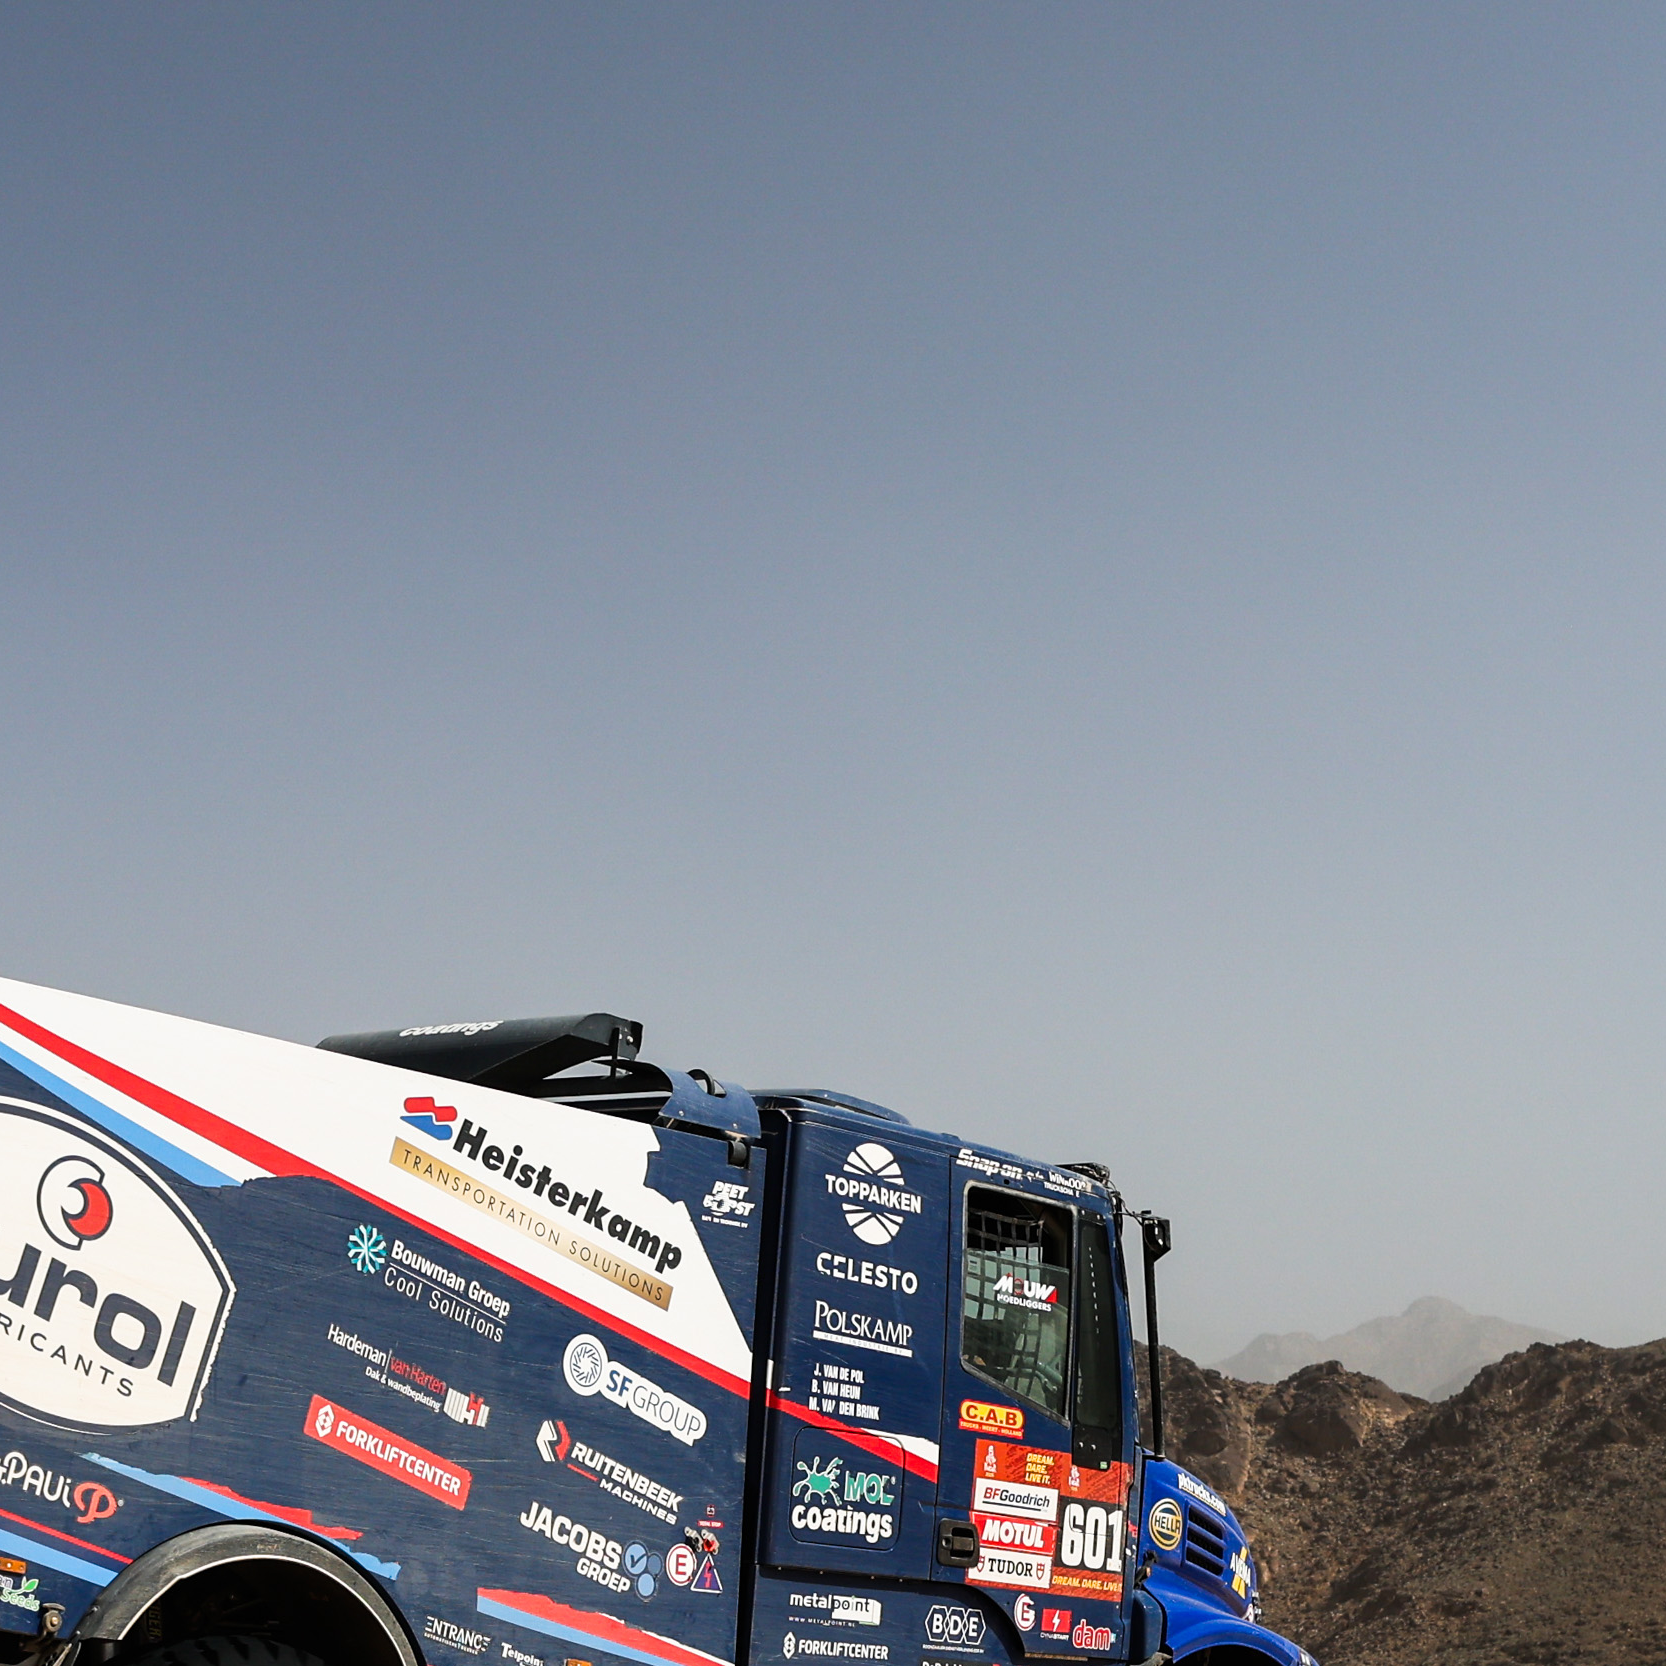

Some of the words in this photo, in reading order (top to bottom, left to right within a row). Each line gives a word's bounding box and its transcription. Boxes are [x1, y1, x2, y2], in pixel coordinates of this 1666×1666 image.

[399, 1020, 504, 1036] coatings
[452, 1118, 683, 1274] Heisterkamp
[712, 1180, 749, 1200] PEET
[824, 1174, 922, 1214] TOPPARKEN
[403, 1149, 561, 1246] TRANSPORTATION
[569, 1240, 664, 1301] SOLUTIONS
[391, 1240, 466, 1292] Bouwman
[468, 1280, 511, 1319] Groep
[816, 1252, 918, 1294] CELESTO
[993, 1275, 1055, 1300] MOUW
[384, 1266, 423, 1300] Cool
[429, 1290, 504, 1343] Solutions
[814, 1300, 912, 1346] POLSKAMP
[327, 1323, 387, 1367] Hardeman
[390, 1356, 410, 1378] van
[411, 1362, 447, 1396] Harten
[813, 1362, 822, 1377] J.
[823, 1364, 839, 1379] VAN
[839, 1367, 850, 1381] DE
[850, 1369, 865, 1384] POL
[365, 1366, 381, 1382] Dak
[380, 1374, 388, 1385] &
[388, 1377, 442, 1413] wandbeplating
[811, 1379, 821, 1393] B.
[823, 1381, 839, 1396] VAN
[606, 1370, 632, 1397] SF
[633, 1385, 701, 1436] GROUP
[809, 1396, 820, 1411] M.
[839, 1401, 855, 1416] DEN
[856, 1403, 880, 1420] BRINK
[966, 1404, 1017, 1426] C.A.B
[1001, 1429, 1022, 1437] HOLLAND
[336, 1420, 462, 1496] FORKLIFTCENTER
[1026, 1463, 1047, 1474] DARE.
[1027, 1453, 1054, 1465] DREAM.
[571, 1442, 684, 1513] RUITENBEEK
[844, 1470, 895, 1506] MOL
[1025, 1472, 1041, 1483] LIVE
[599, 1478, 678, 1526] MACHINES
[984, 1487, 1050, 1508] BFGoodrich
[520, 1501, 623, 1570] JACOBS
[792, 1504, 893, 1543] coatings
[981, 1519, 1044, 1548] MOTUL
[1154, 1513, 1181, 1536] HELLA
[1061, 1503, 1123, 1572] 601
[576, 1557, 631, 1594] GROEP
[676, 1554, 687, 1575] E
[988, 1558, 1033, 1577] TUDOR
[1052, 1575, 1081, 1587] DREAM.
[1082, 1580, 1103, 1591] DARE.
[0, 1587, 40, 1612] Seeds
[789, 1592, 870, 1612] metalpoint
[1022, 1602, 1031, 1621] E
[424, 1615, 491, 1652] ENTRANCE
[798, 1639, 889, 1660] FORKLIFTCENTER
